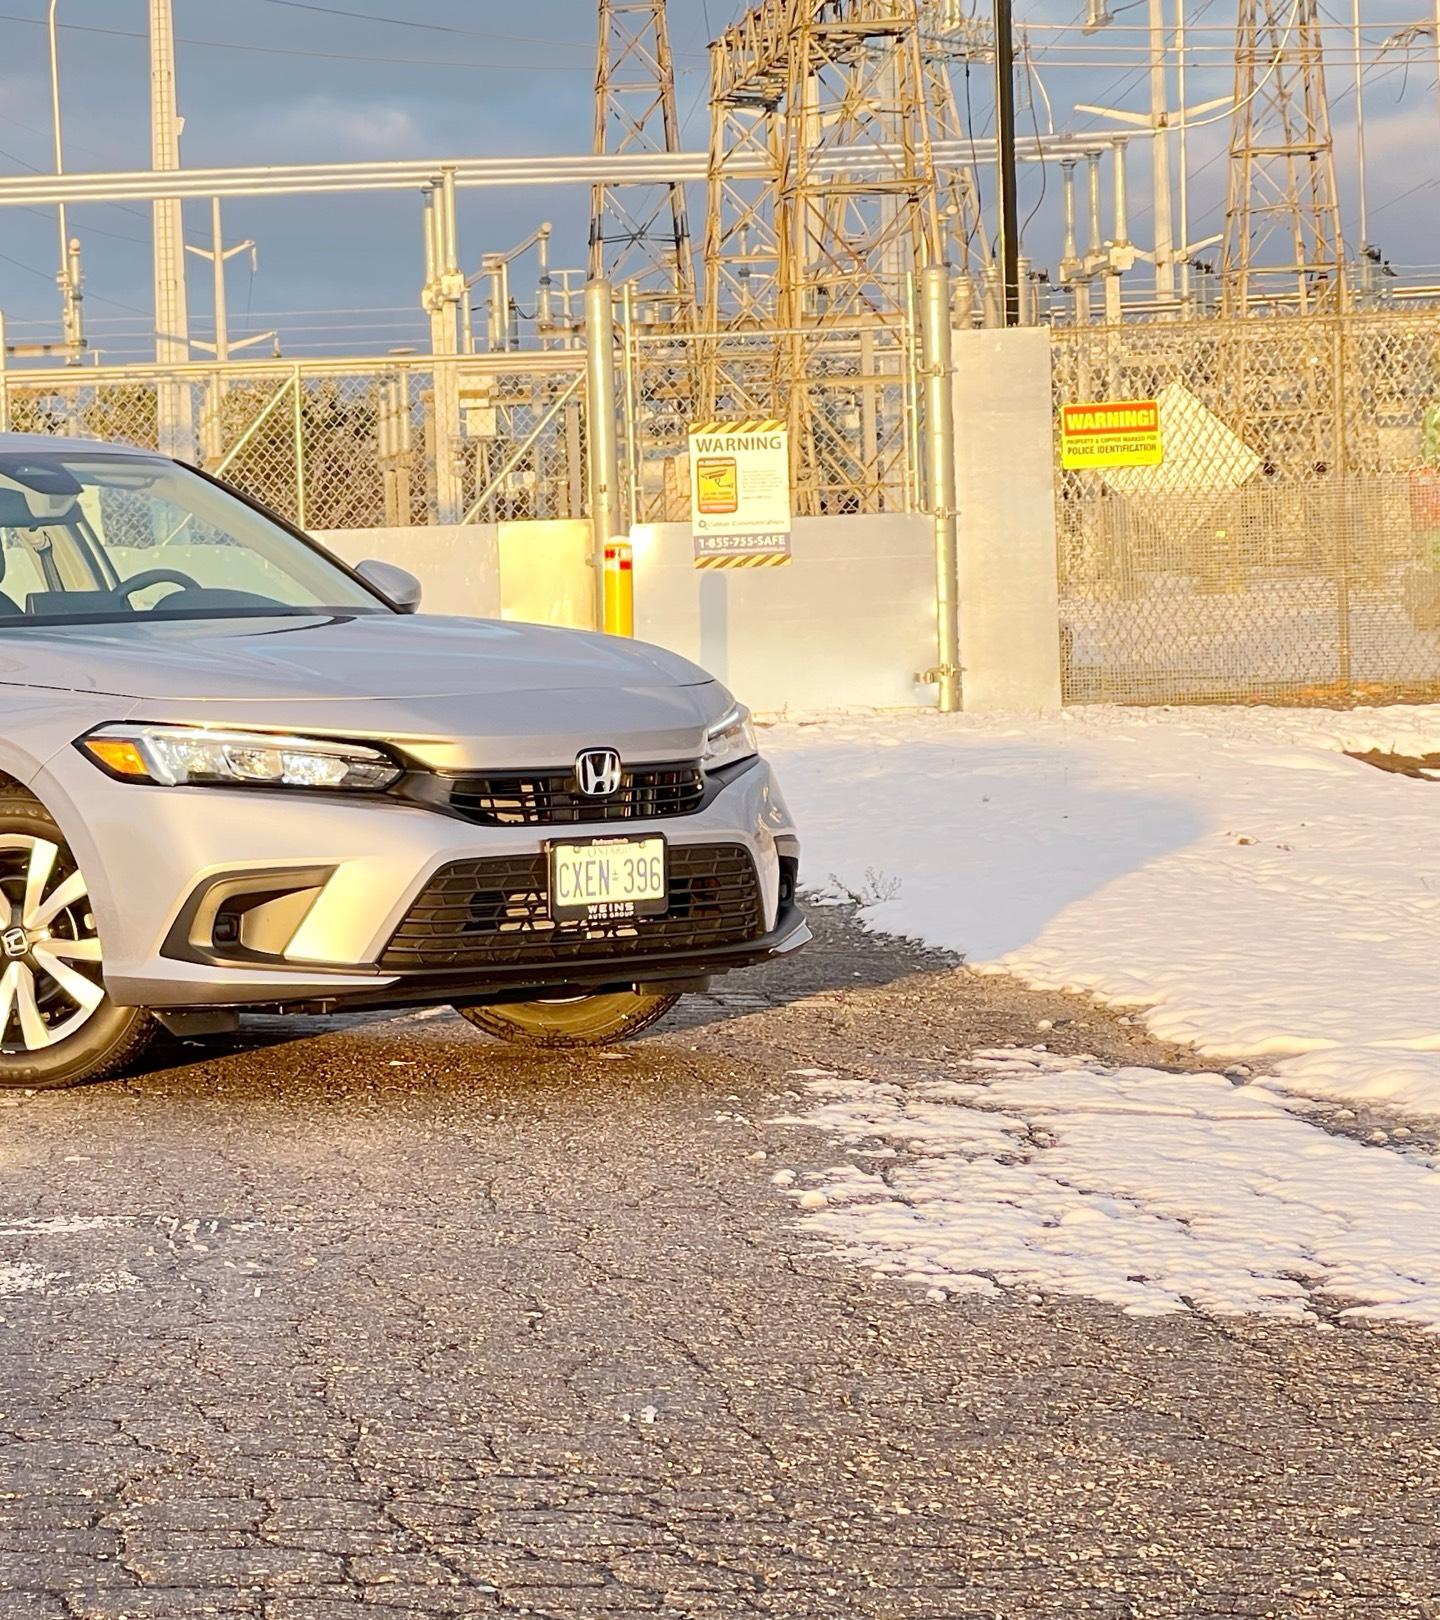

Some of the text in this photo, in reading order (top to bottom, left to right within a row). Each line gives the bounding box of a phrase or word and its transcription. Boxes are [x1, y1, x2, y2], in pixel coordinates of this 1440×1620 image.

[1067, 409, 1155, 431] WARNING!
[695, 436, 782, 453] WARNING
[1067, 443, 1157, 456] POLICE IDENTIFICATION
[698, 535, 786, 549] 1-855-755-SAFE
[559, 856, 661, 898] CXEN 396
[587, 902, 635, 914] WEINS
[588, 911, 634, 920] AUTO GROUP
